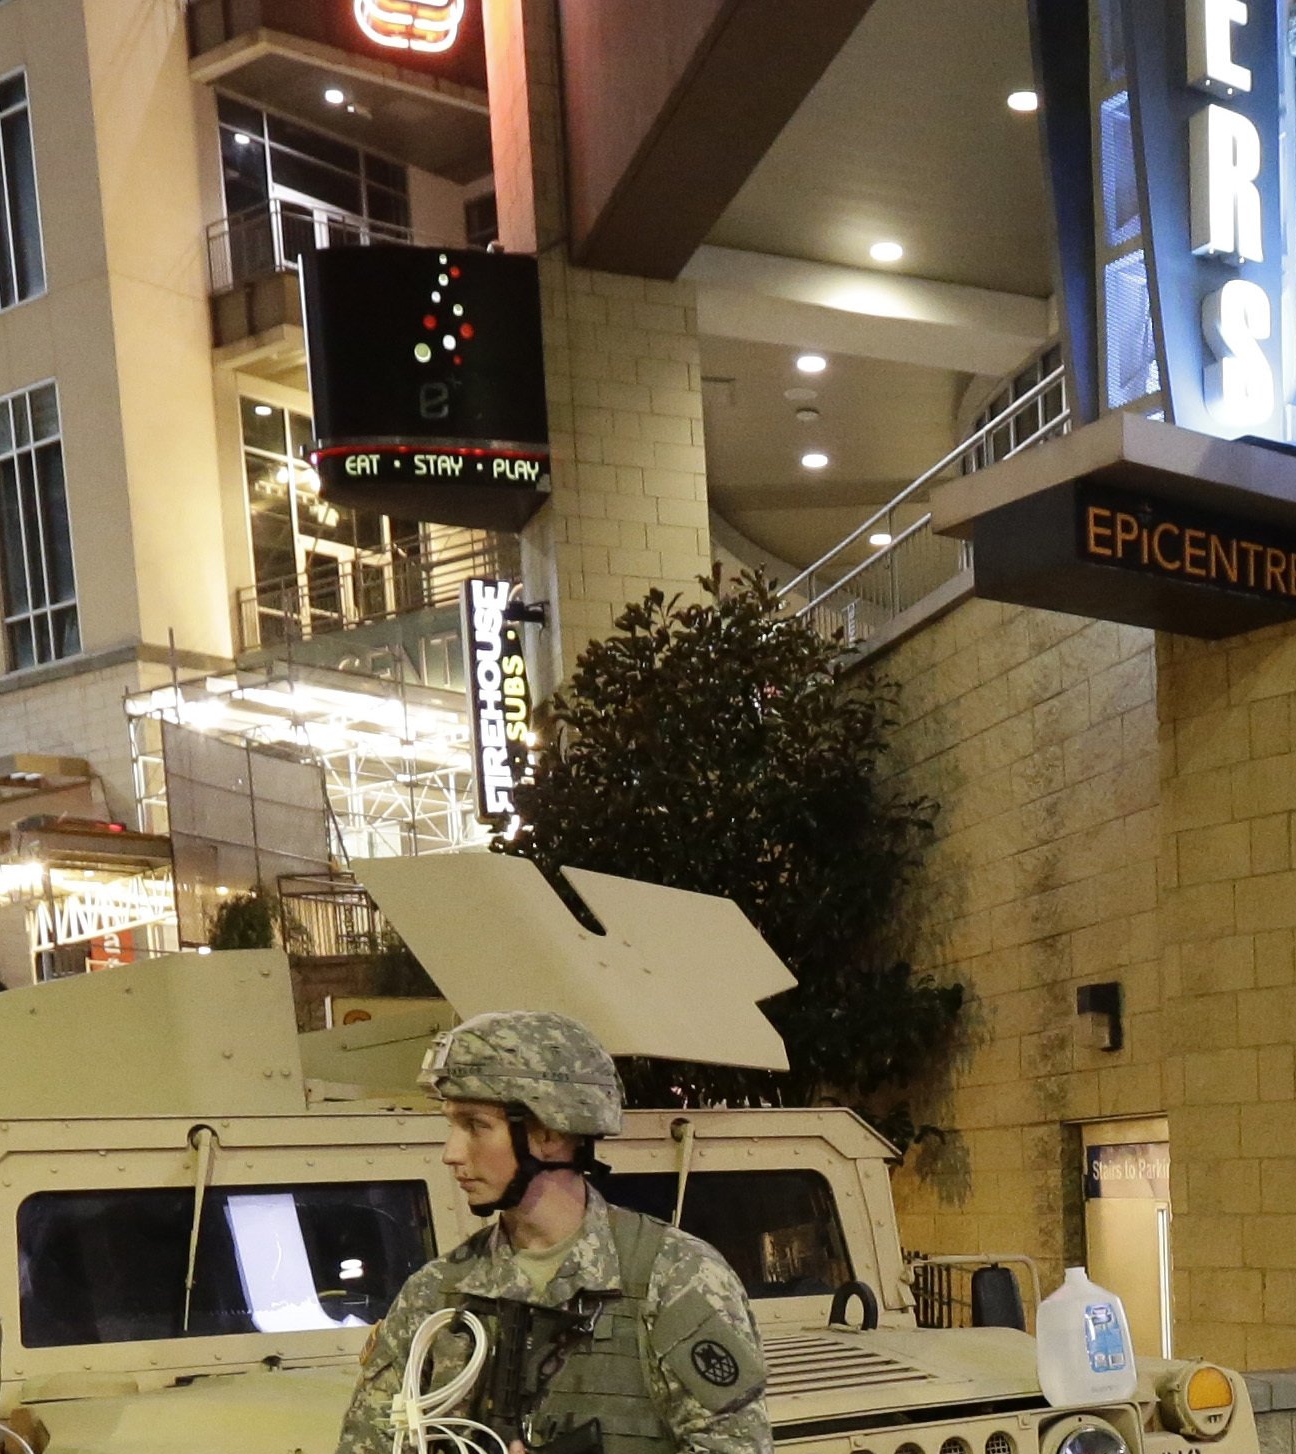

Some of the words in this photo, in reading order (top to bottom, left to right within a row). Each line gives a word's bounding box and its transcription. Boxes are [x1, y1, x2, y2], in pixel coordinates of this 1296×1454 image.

[345, 454, 380, 475] EAT
[414, 454, 463, 476] STAY
[493, 458, 539, 481] PLAY
[470, 579, 515, 814] FIREHOUSE
[502, 654, 530, 742] SUBS
